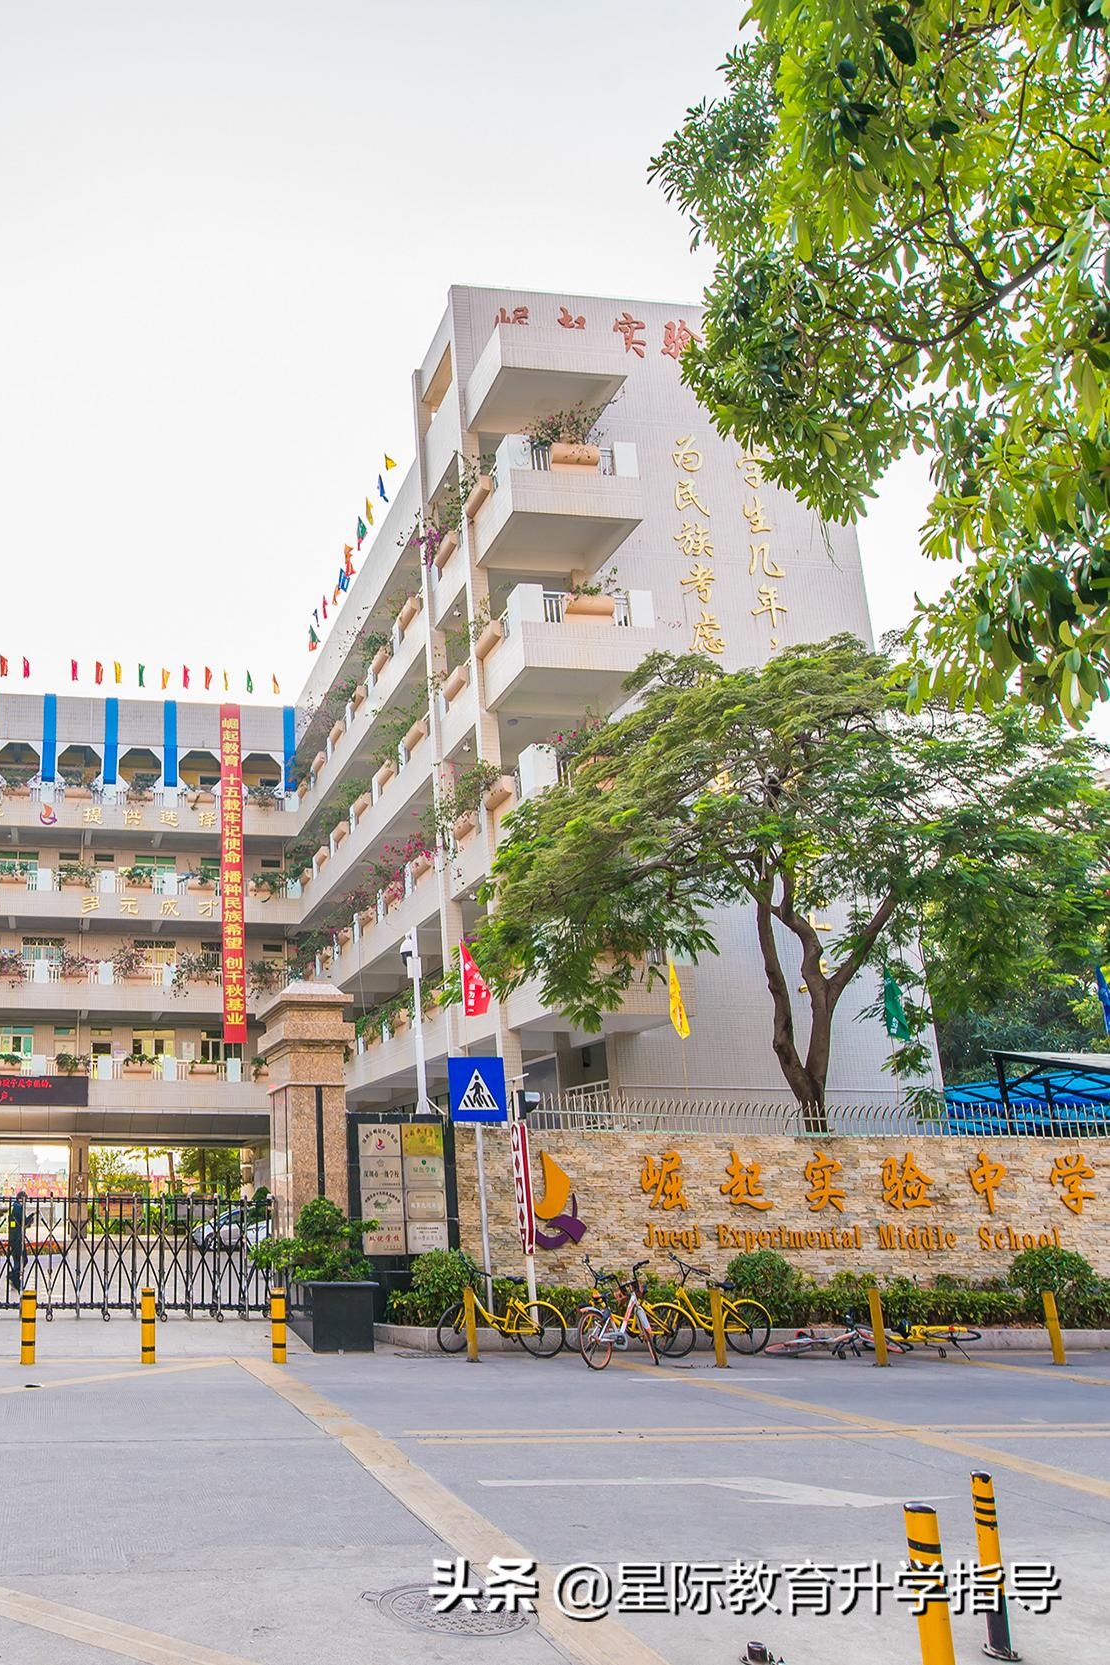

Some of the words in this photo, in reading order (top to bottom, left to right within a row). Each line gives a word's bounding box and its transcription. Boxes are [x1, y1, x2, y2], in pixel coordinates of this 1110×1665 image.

[221, 718, 239, 767] 崛起教育
[83, 806, 218, 828] 提供选择
[223, 773, 241, 863] 十五载牢记使命
[81, 896, 219, 917] 多元成才
[223, 870, 243, 950] 播种民族希望
[225, 956, 245, 1025] 创千秋基业
[641, 1151, 1096, 1215] 崛起实验中学
[643, 1223, 701, 1253] Jueqi
[718, 1224, 861, 1254] Experimental
[879, 1225, 956, 1250] Middle
[979, 1226, 1060, 1250] School
